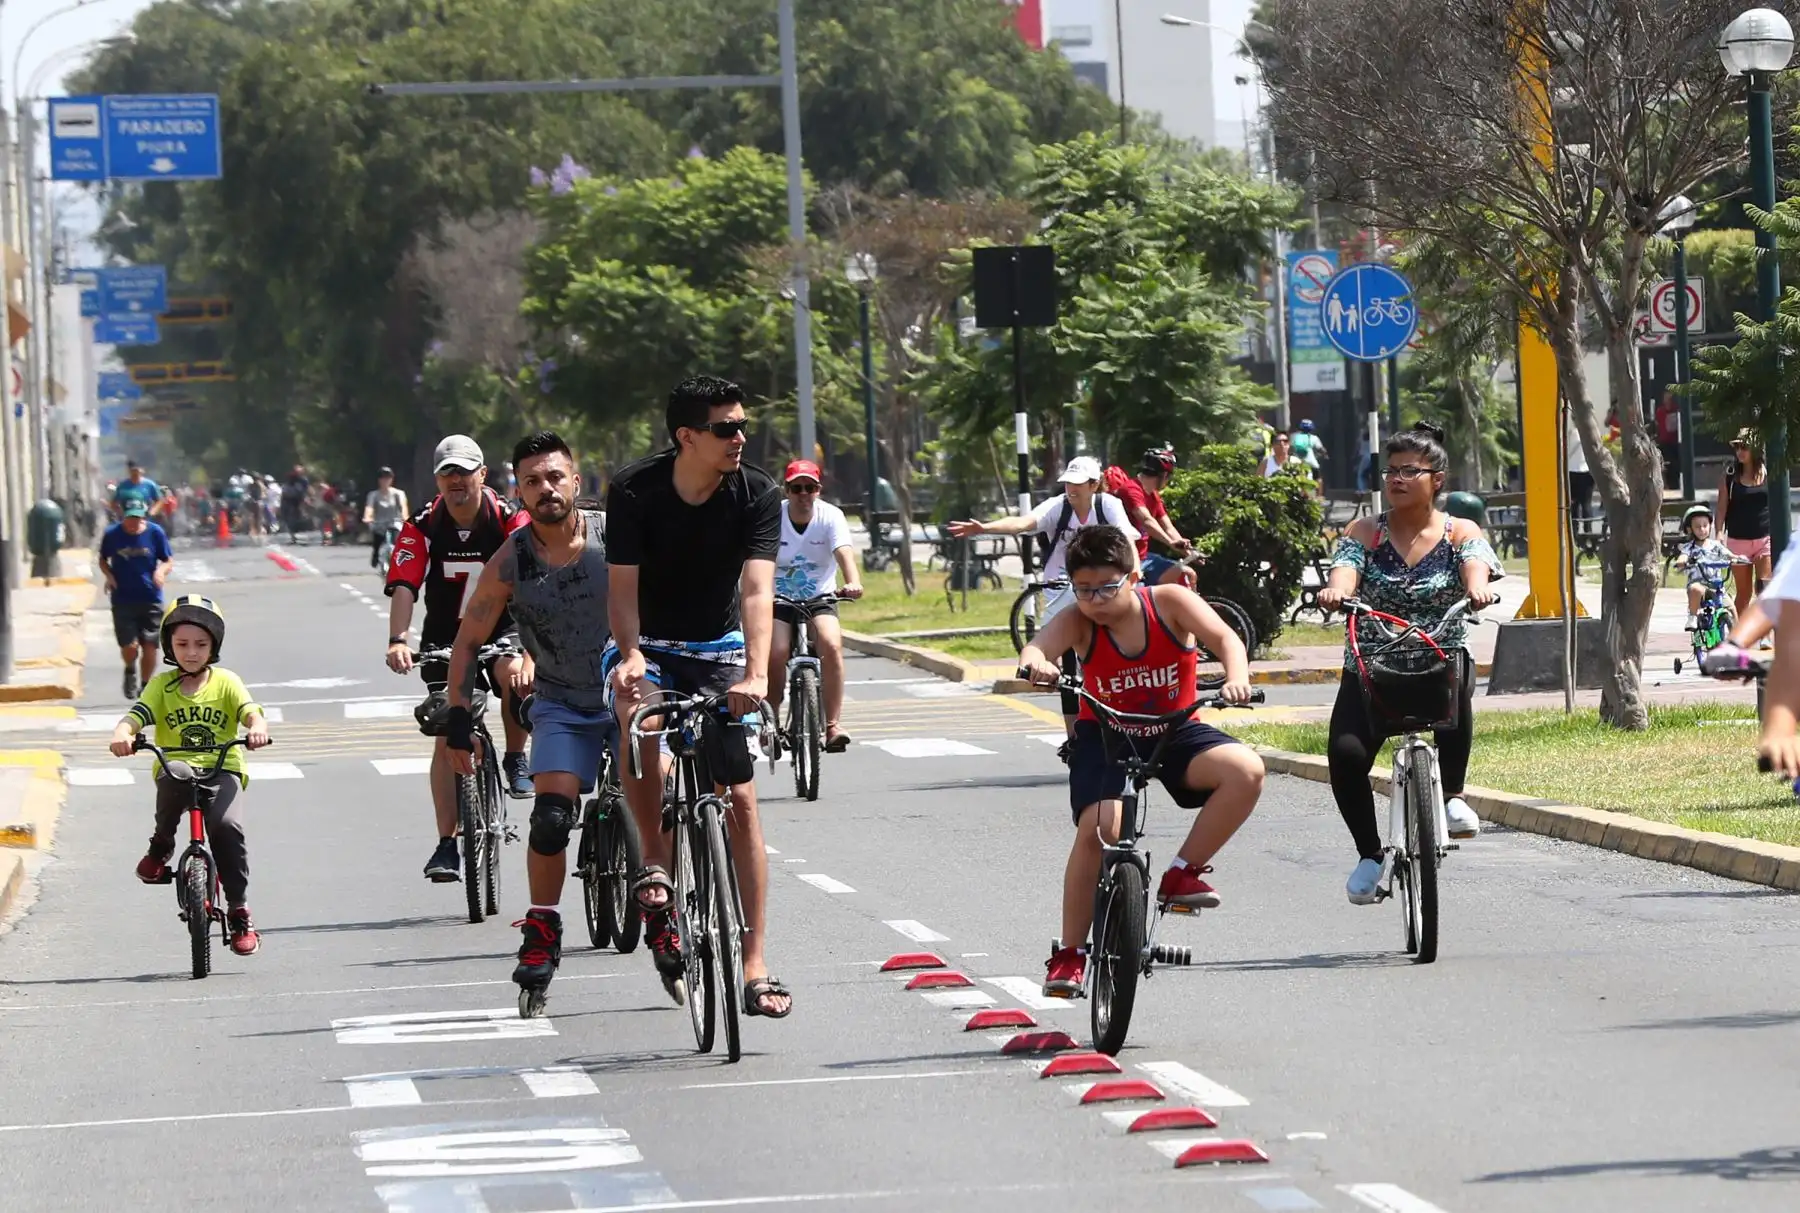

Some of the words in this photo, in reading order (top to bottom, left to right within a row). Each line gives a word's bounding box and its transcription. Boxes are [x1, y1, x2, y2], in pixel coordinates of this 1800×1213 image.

[117, 119, 207, 134] PARADERO
[442, 561, 485, 619] 7
[1117, 664, 1150, 676] FOOTBALL
[1094, 662, 1180, 694] LEAGUE
[1168, 687, 1180, 700] 07
